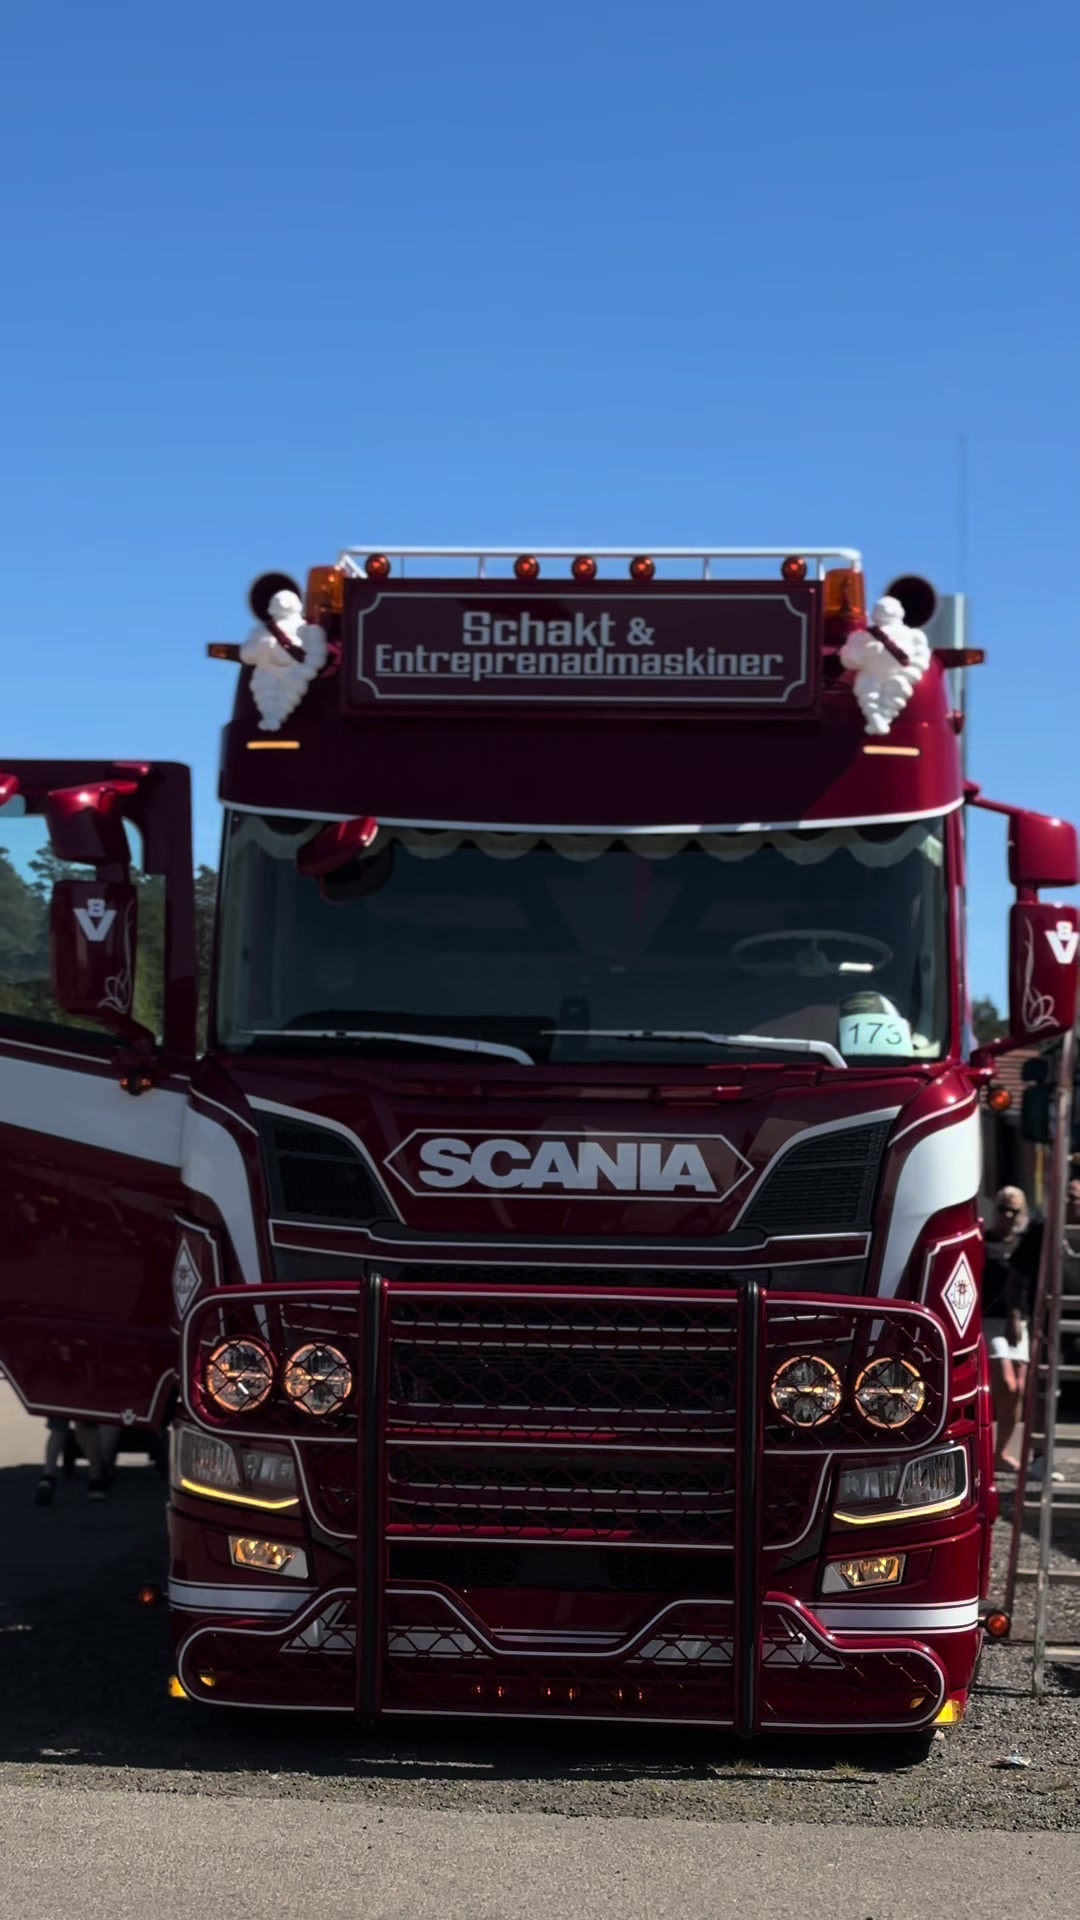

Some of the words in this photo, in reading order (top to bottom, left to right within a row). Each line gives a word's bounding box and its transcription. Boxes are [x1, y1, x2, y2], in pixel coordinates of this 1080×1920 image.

[463, 612, 616, 646] Schakt
[627, 617, 655, 646] &
[375, 644, 784, 681] Entreprenadmaskiner
[848, 1022, 903, 1045] 173
[418, 1138, 718, 1192] SCANIA
